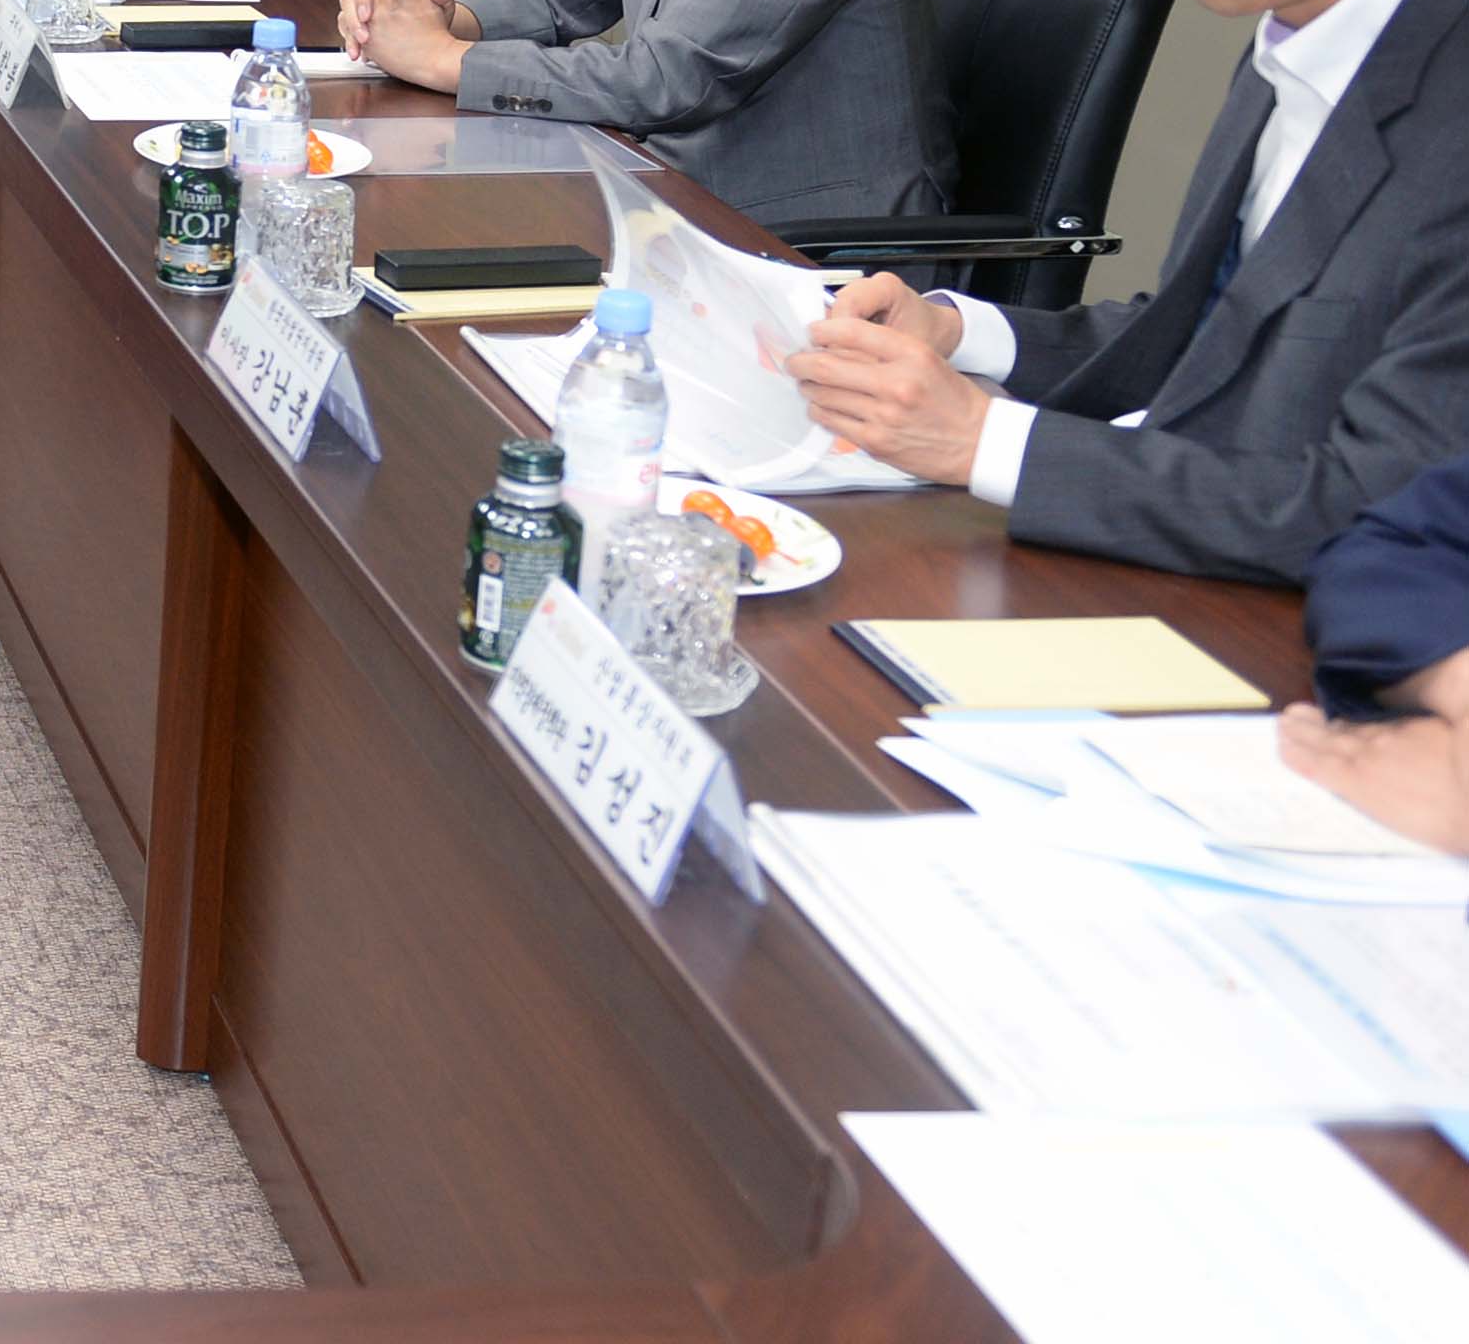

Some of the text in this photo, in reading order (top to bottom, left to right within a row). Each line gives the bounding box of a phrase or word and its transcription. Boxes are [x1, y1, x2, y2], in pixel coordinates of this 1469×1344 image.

[166, 208, 230, 239] T.O.P
[174, 189, 222, 207] Maxim
[251, 348, 309, 436] 강남훈
[574, 724, 673, 866] 김성진
